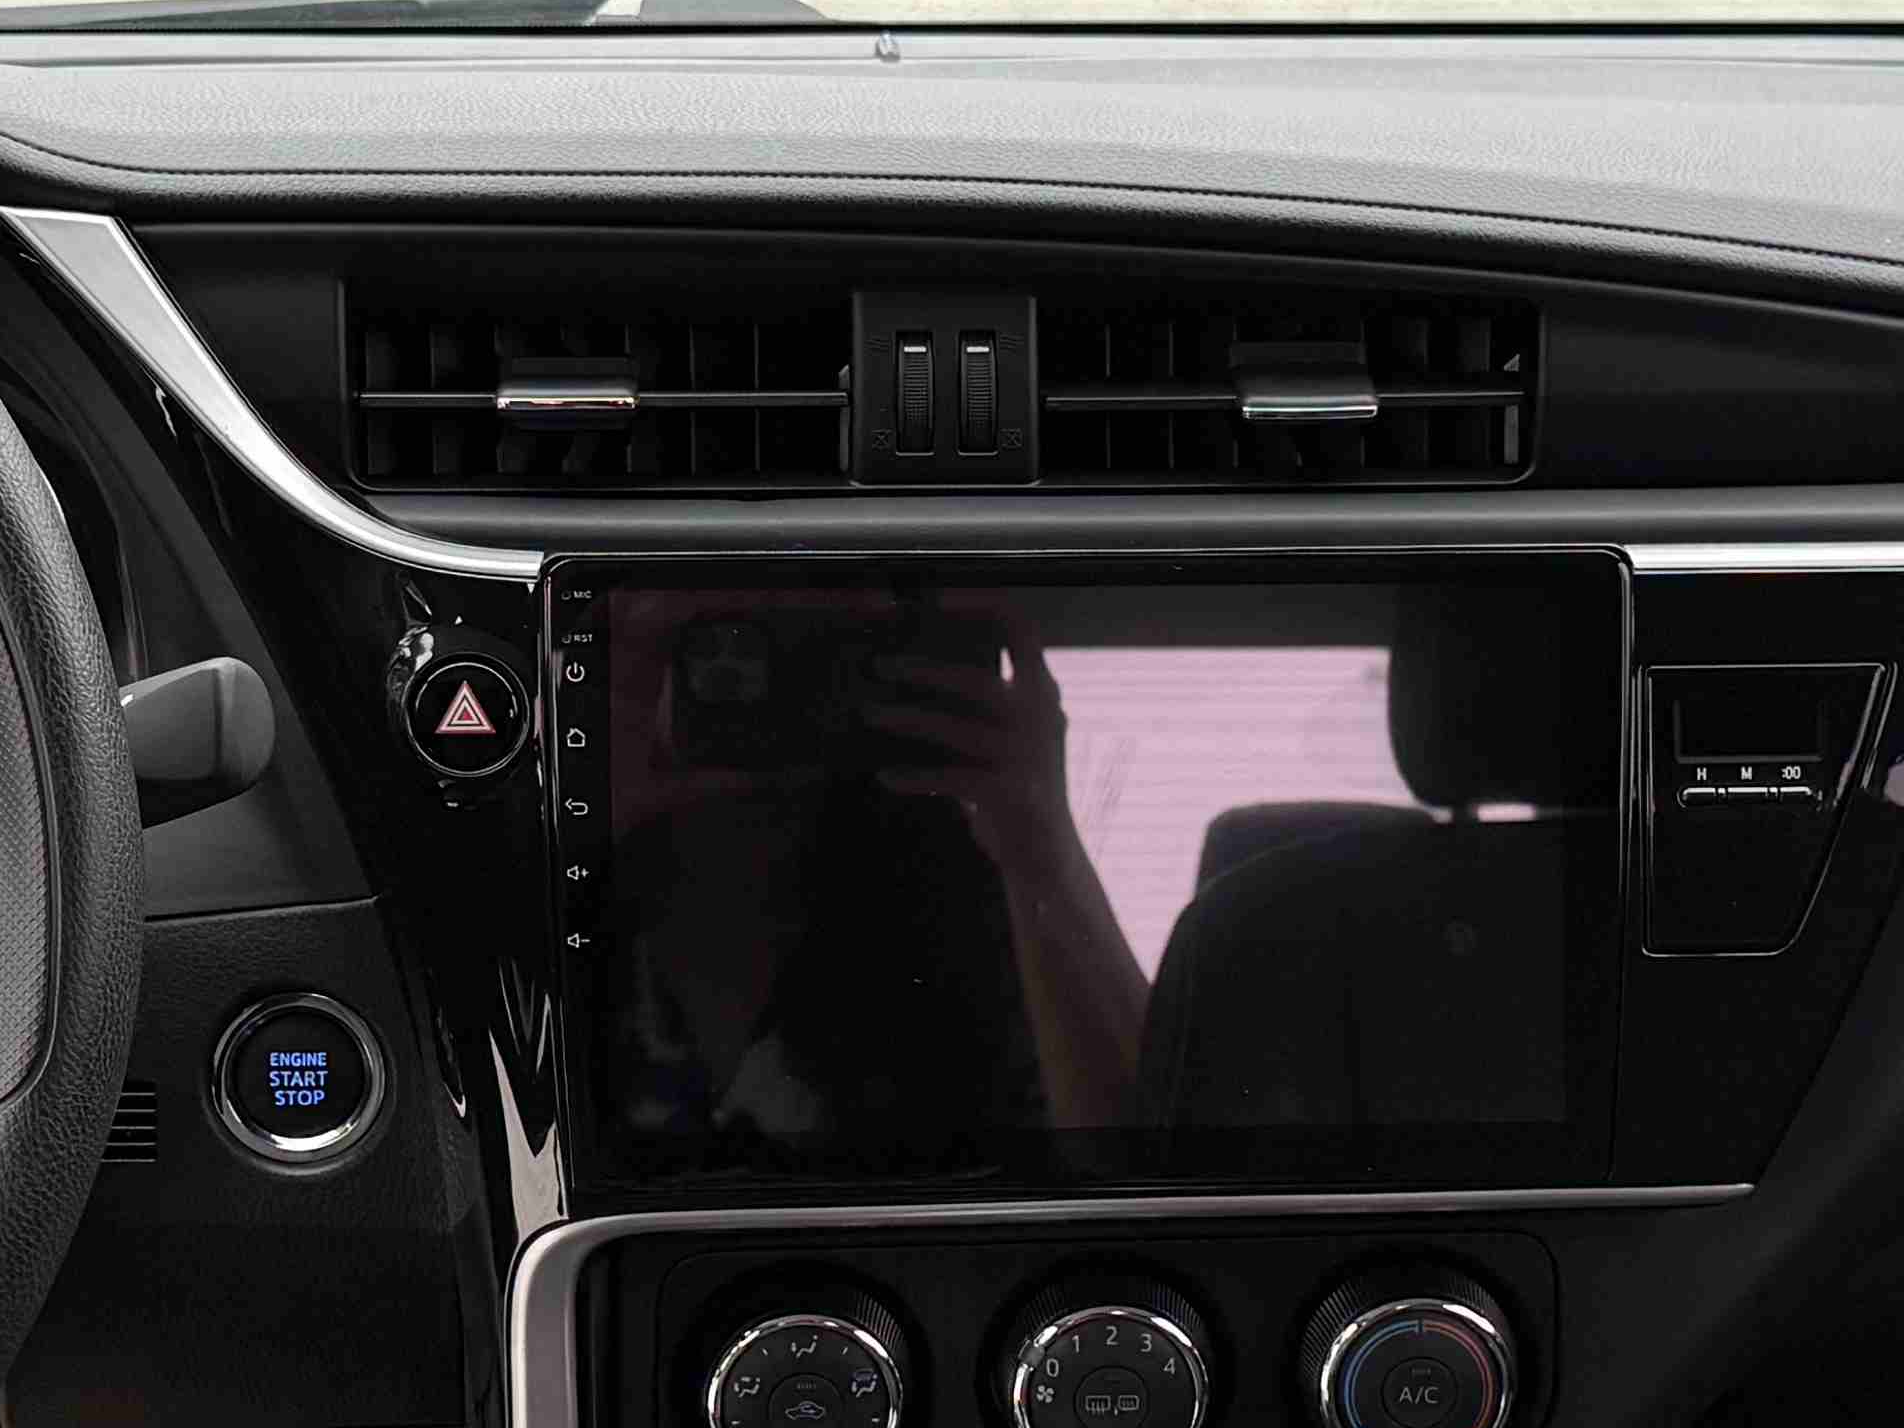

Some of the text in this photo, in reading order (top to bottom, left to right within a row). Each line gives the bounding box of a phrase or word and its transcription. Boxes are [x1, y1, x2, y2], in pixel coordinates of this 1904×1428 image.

[1696, 767, 1707, 781] H
[1740, 767, 1752, 780] M
[270, 1052, 327, 1067] ENGINE
[269, 1071, 328, 1087] START
[275, 1091, 325, 1106] STOP
[1071, 1334, 1081, 1353] 1
[1105, 1325, 1118, 1346] 2
[1140, 1333, 1153, 1353] 3
[1045, 1357, 1060, 1377] 0
[1163, 1357, 1176, 1375] 4
[1398, 1386, 1439, 1405] A/C
